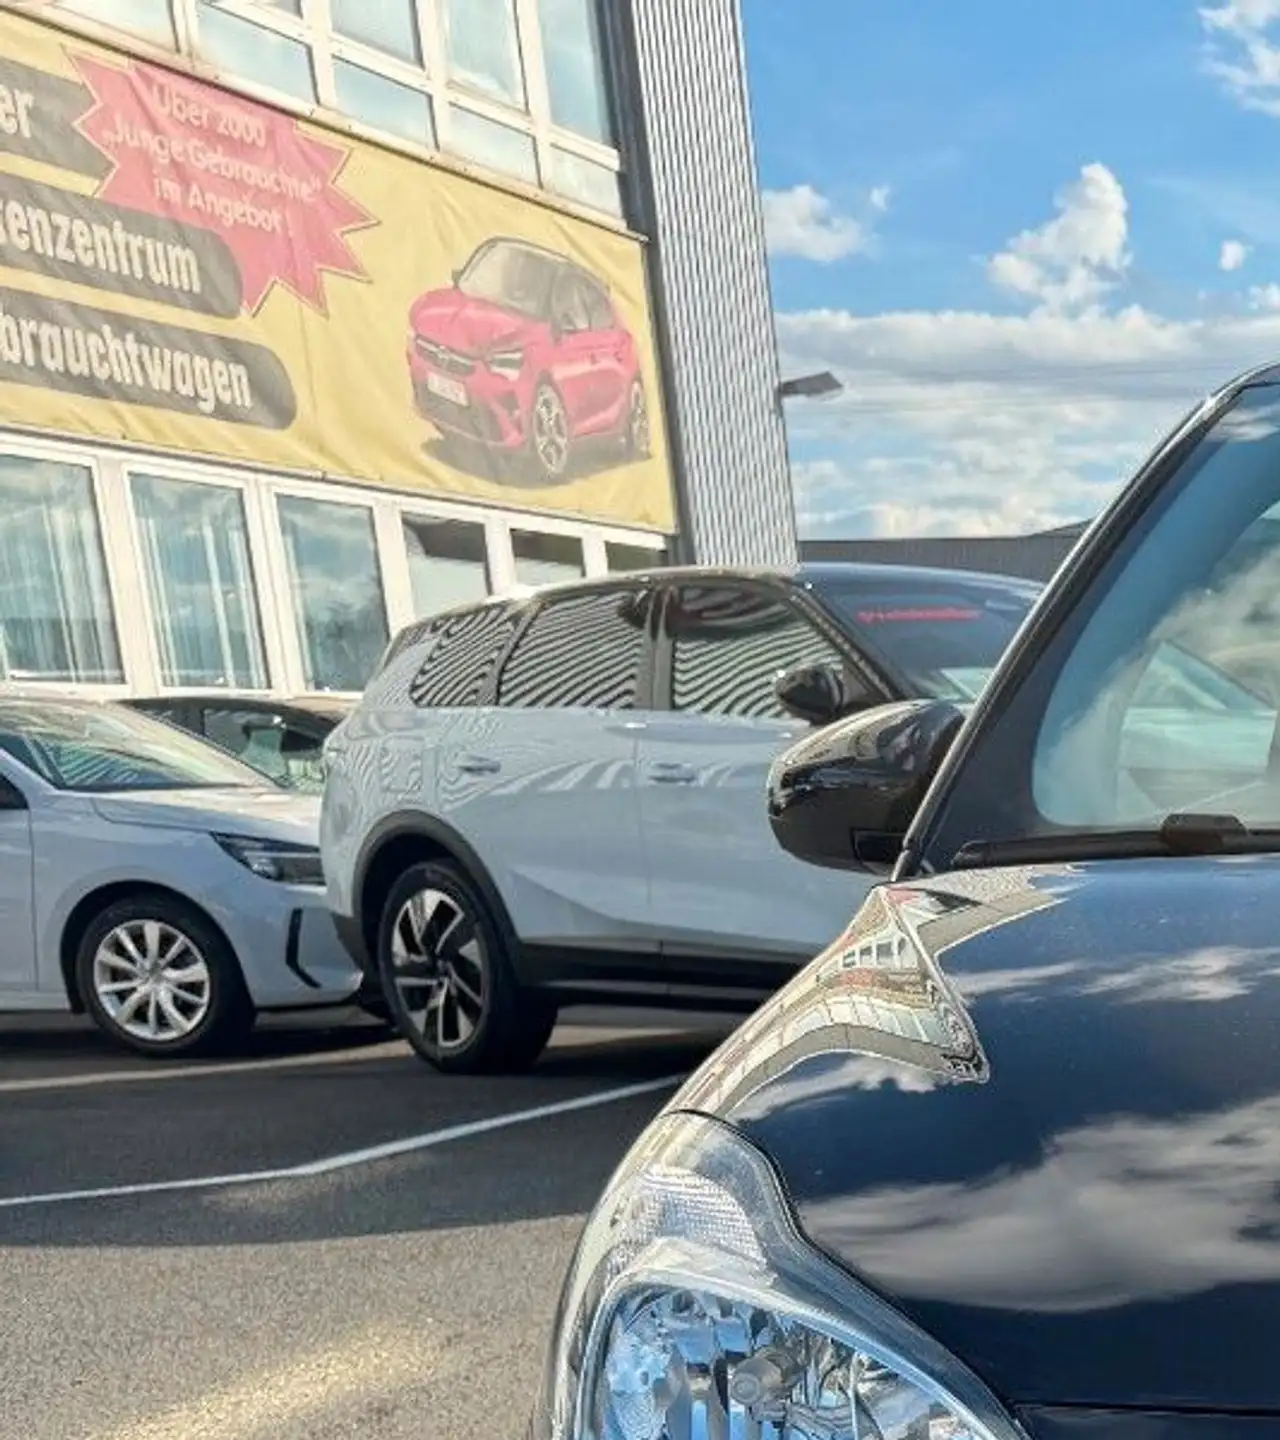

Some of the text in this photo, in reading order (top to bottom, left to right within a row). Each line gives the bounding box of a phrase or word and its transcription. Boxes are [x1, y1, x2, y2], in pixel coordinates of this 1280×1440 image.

[218, 109, 267, 147] 2000
[153, 168, 182, 204] im
[0, 199, 202, 296] enzentrum
